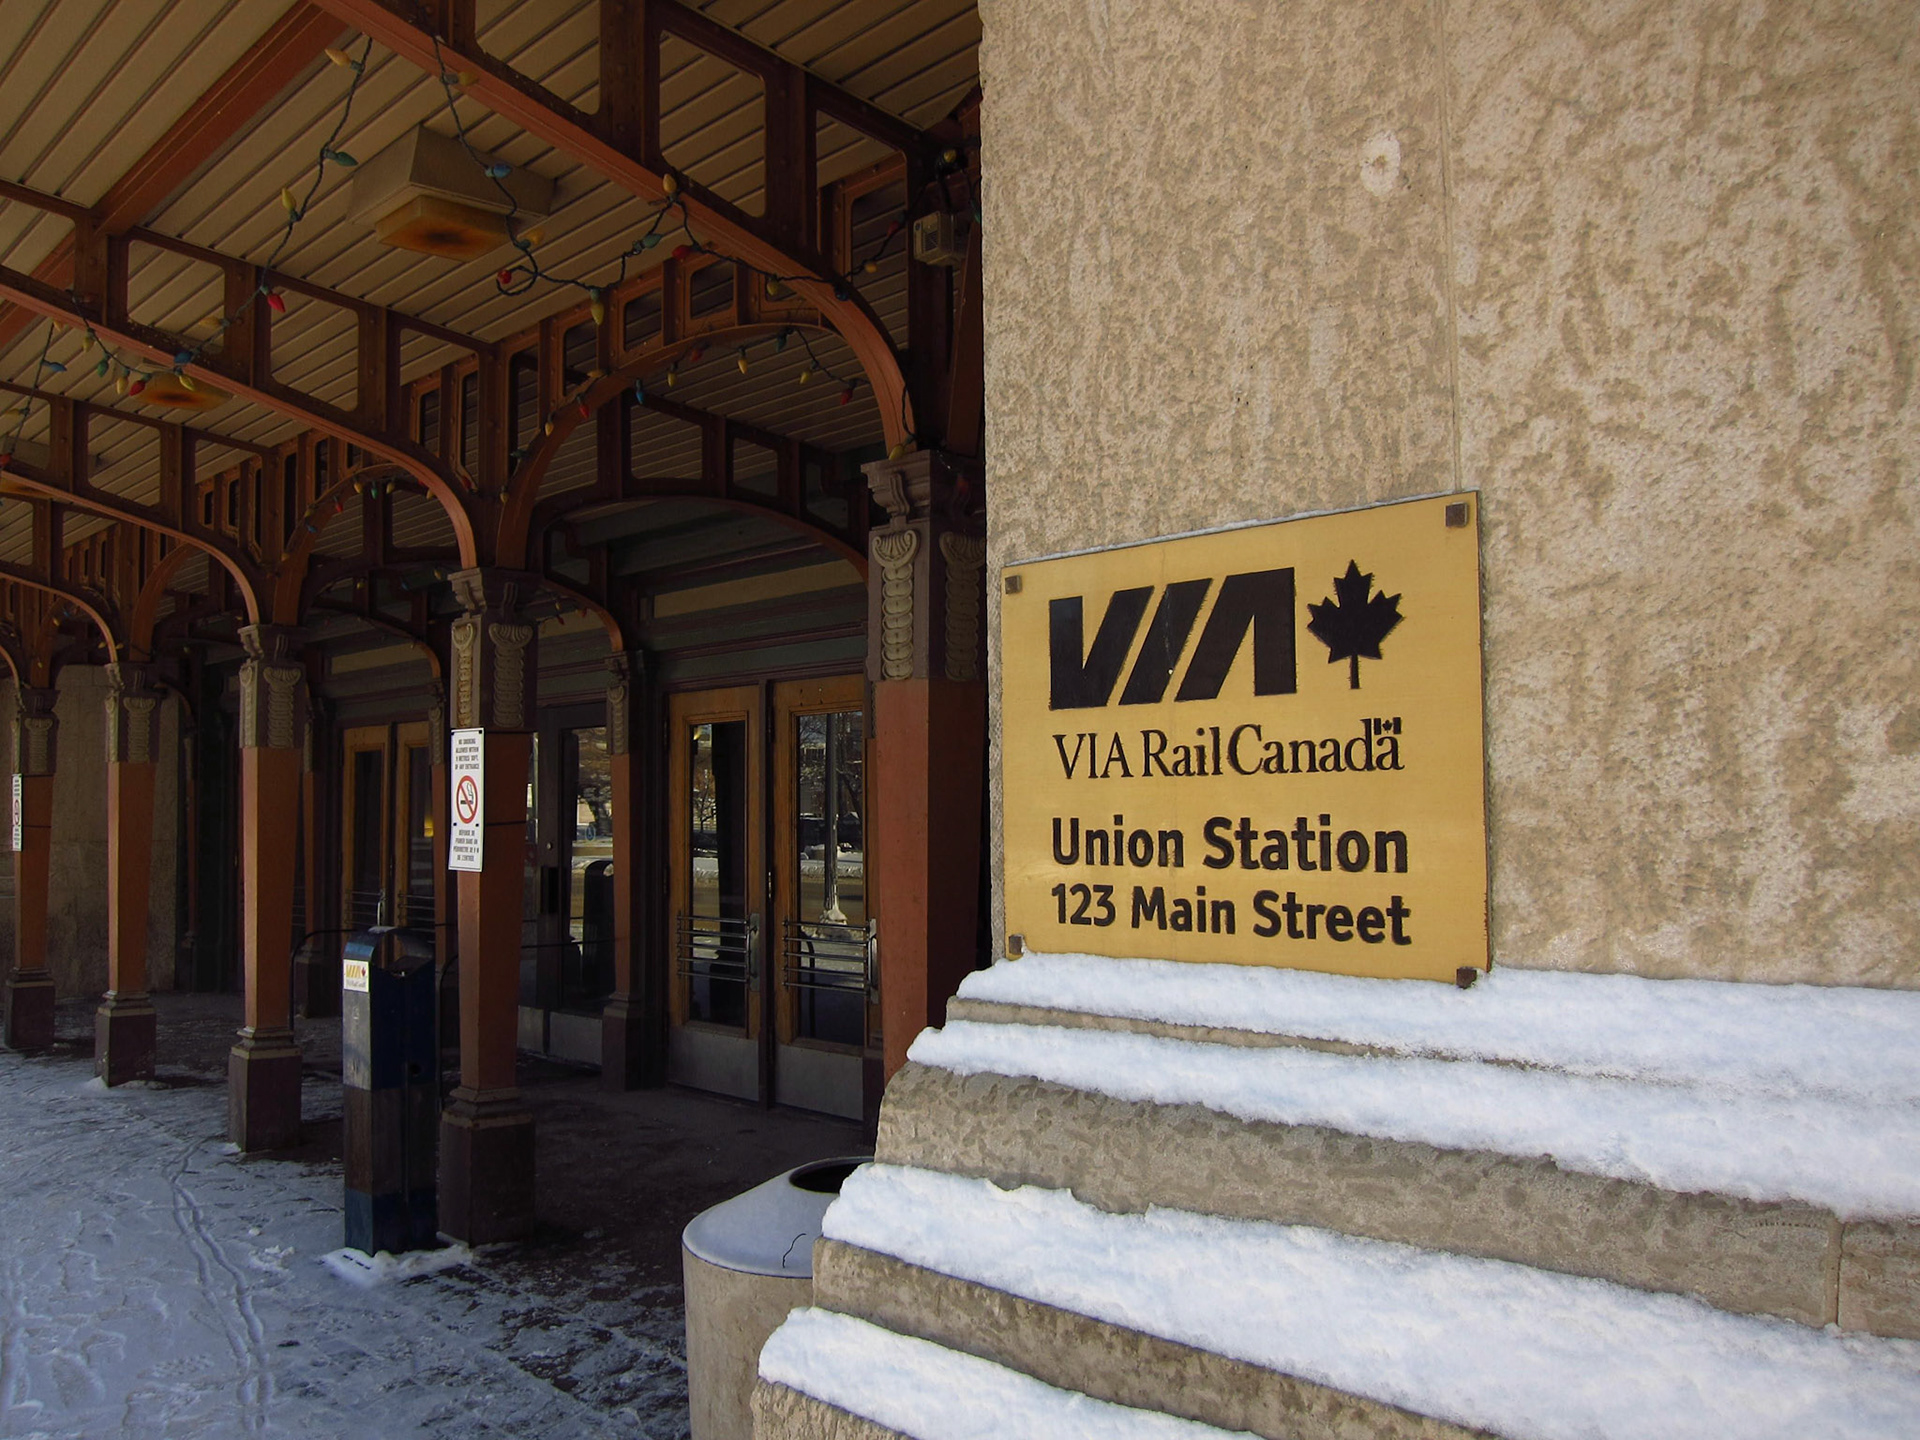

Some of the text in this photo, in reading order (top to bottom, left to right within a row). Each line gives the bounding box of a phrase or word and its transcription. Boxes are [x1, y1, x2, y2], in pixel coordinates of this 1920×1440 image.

[1049, 567, 1297, 711] VIA
[1053, 717, 1406, 780] VIA Rail Canada
[1052, 814, 1408, 874] Union Station
[1051, 883, 1412, 946] 123 Main Street
